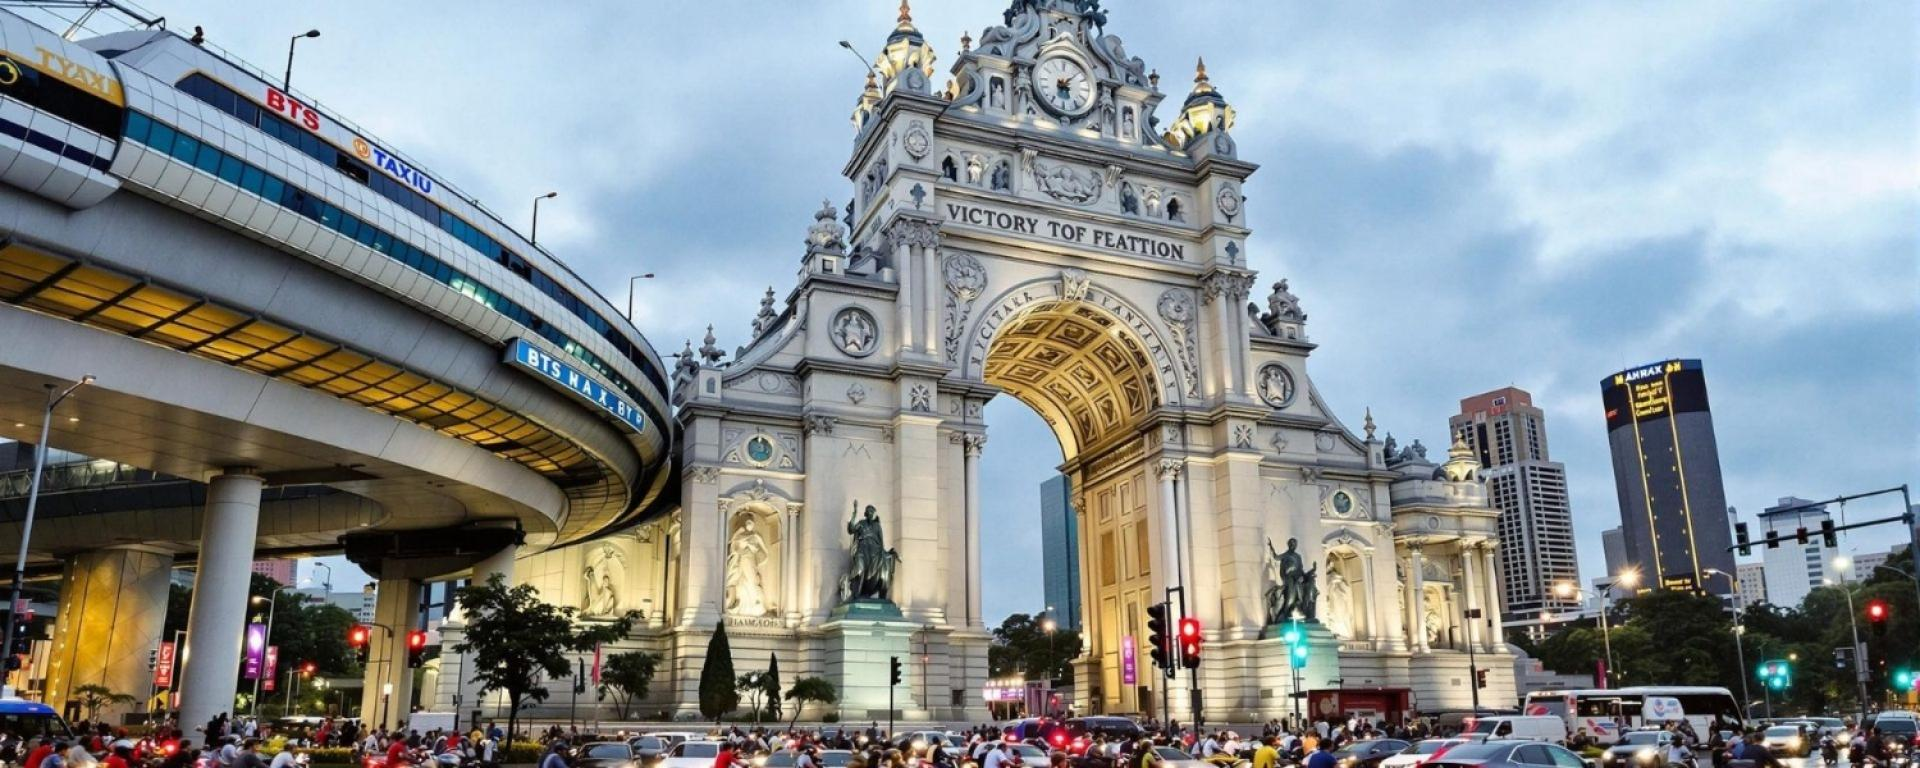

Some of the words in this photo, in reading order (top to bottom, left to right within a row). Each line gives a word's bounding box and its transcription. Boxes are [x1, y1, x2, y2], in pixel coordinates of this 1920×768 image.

[266, 87, 320, 132] BTS
[373, 148, 432, 194] TAXIU
[947, 203, 1039, 234] VICTORY
[1047, 220, 1087, 244] TOF
[1093, 230, 1184, 260] FEATTION
[527, 347, 561, 378] BTS
